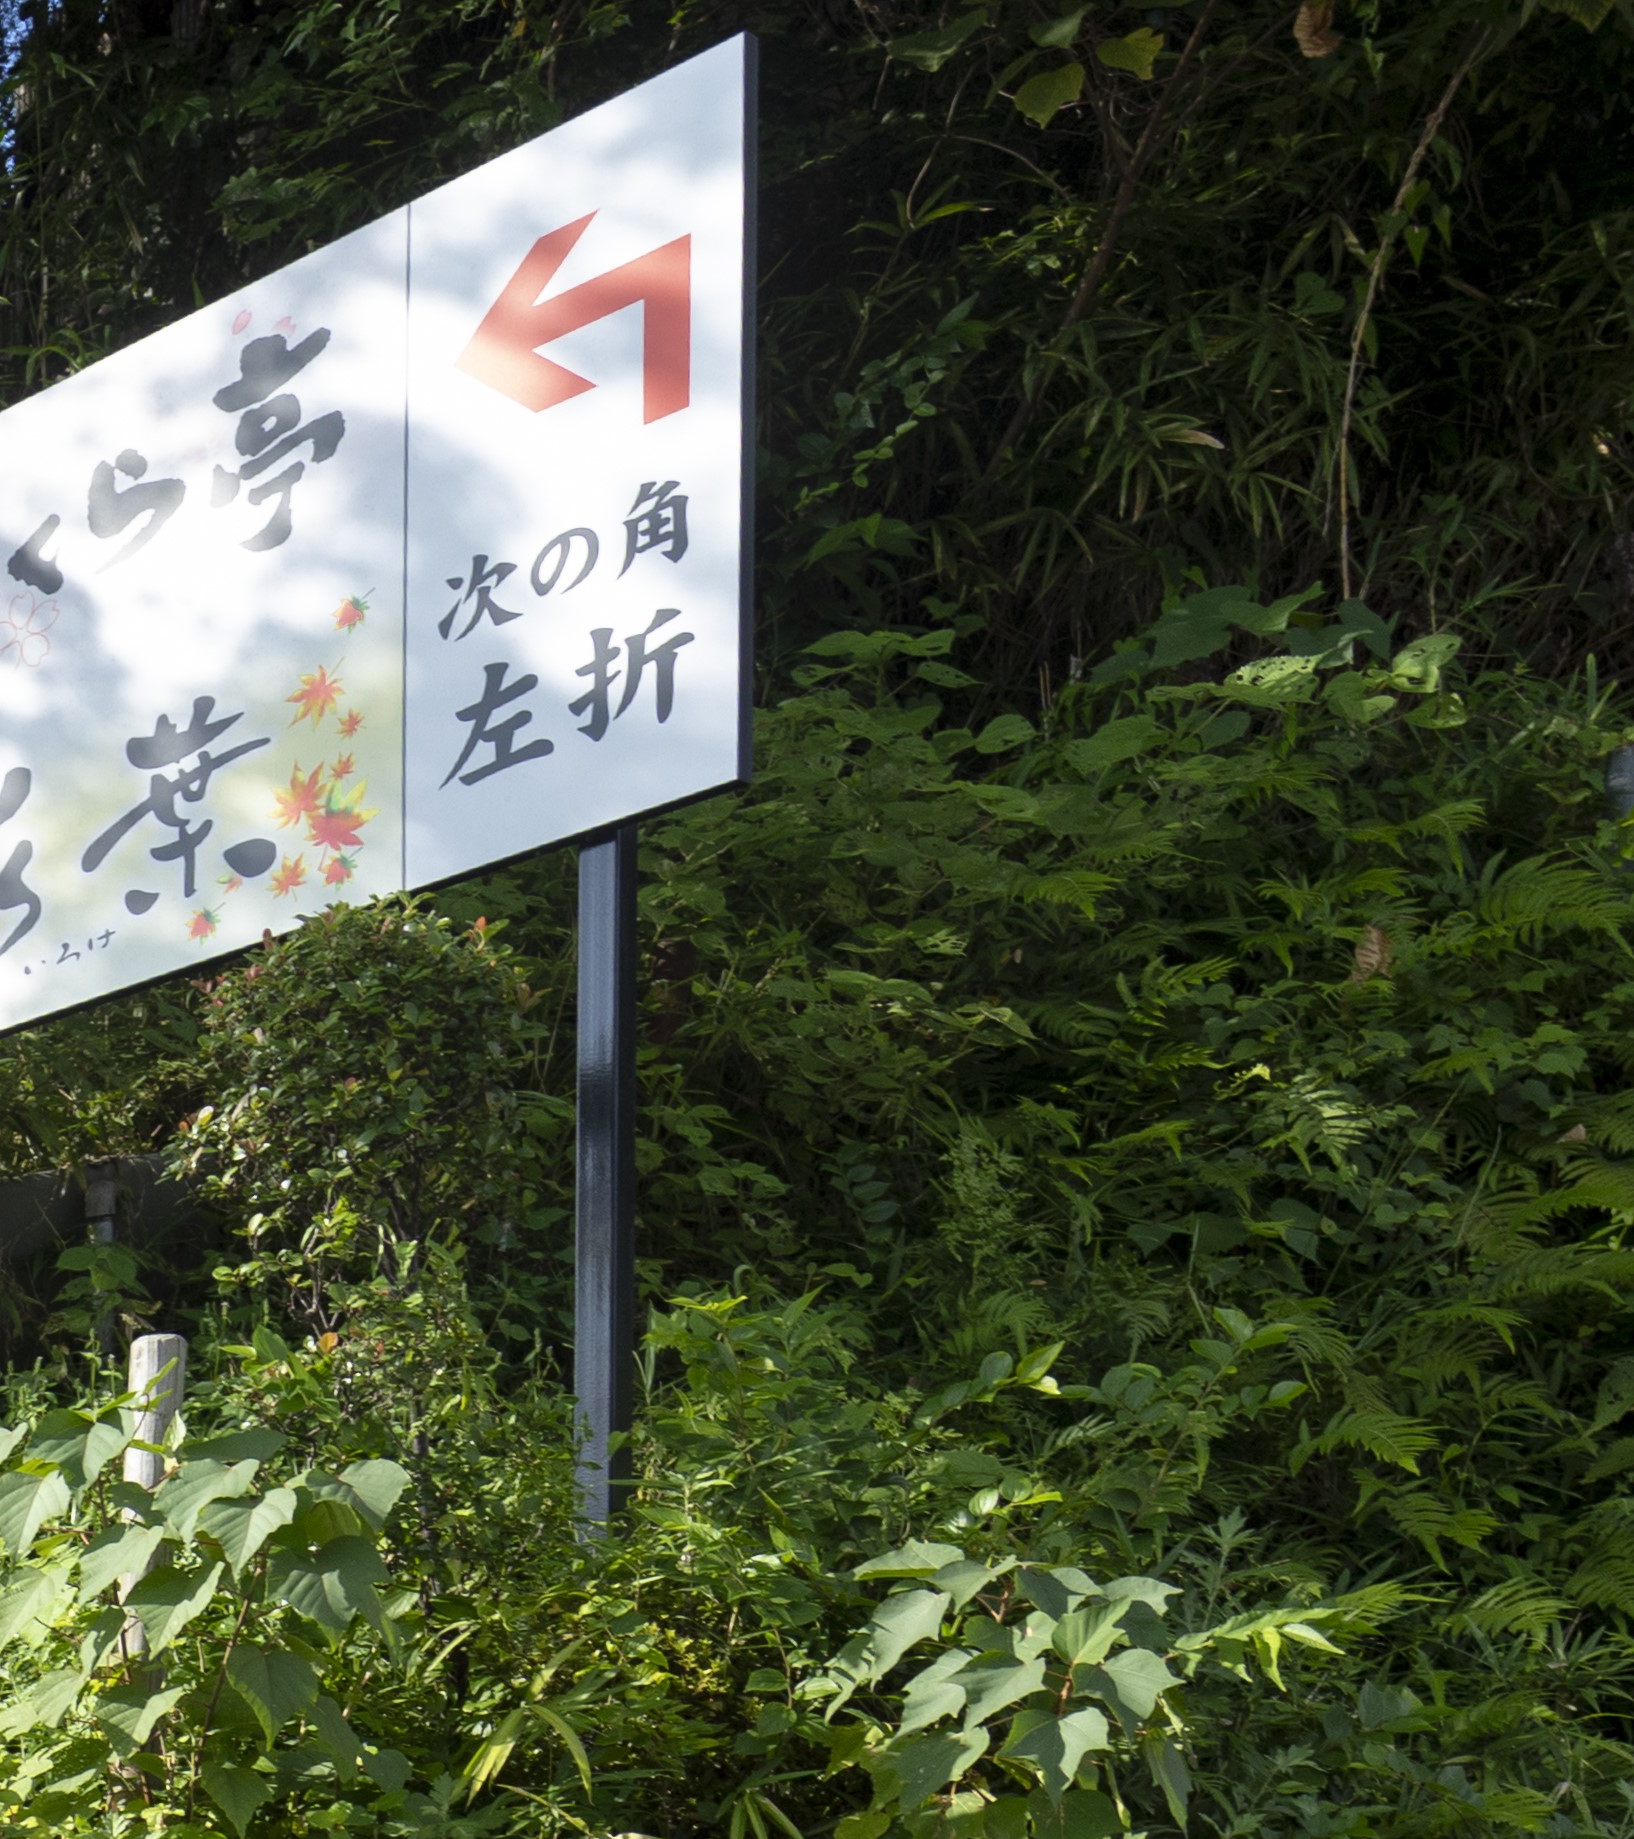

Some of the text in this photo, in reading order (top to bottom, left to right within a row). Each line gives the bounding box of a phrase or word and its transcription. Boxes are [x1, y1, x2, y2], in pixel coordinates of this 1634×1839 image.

[438, 480, 690, 643] 次の角
[438, 608, 696, 791] 左折
